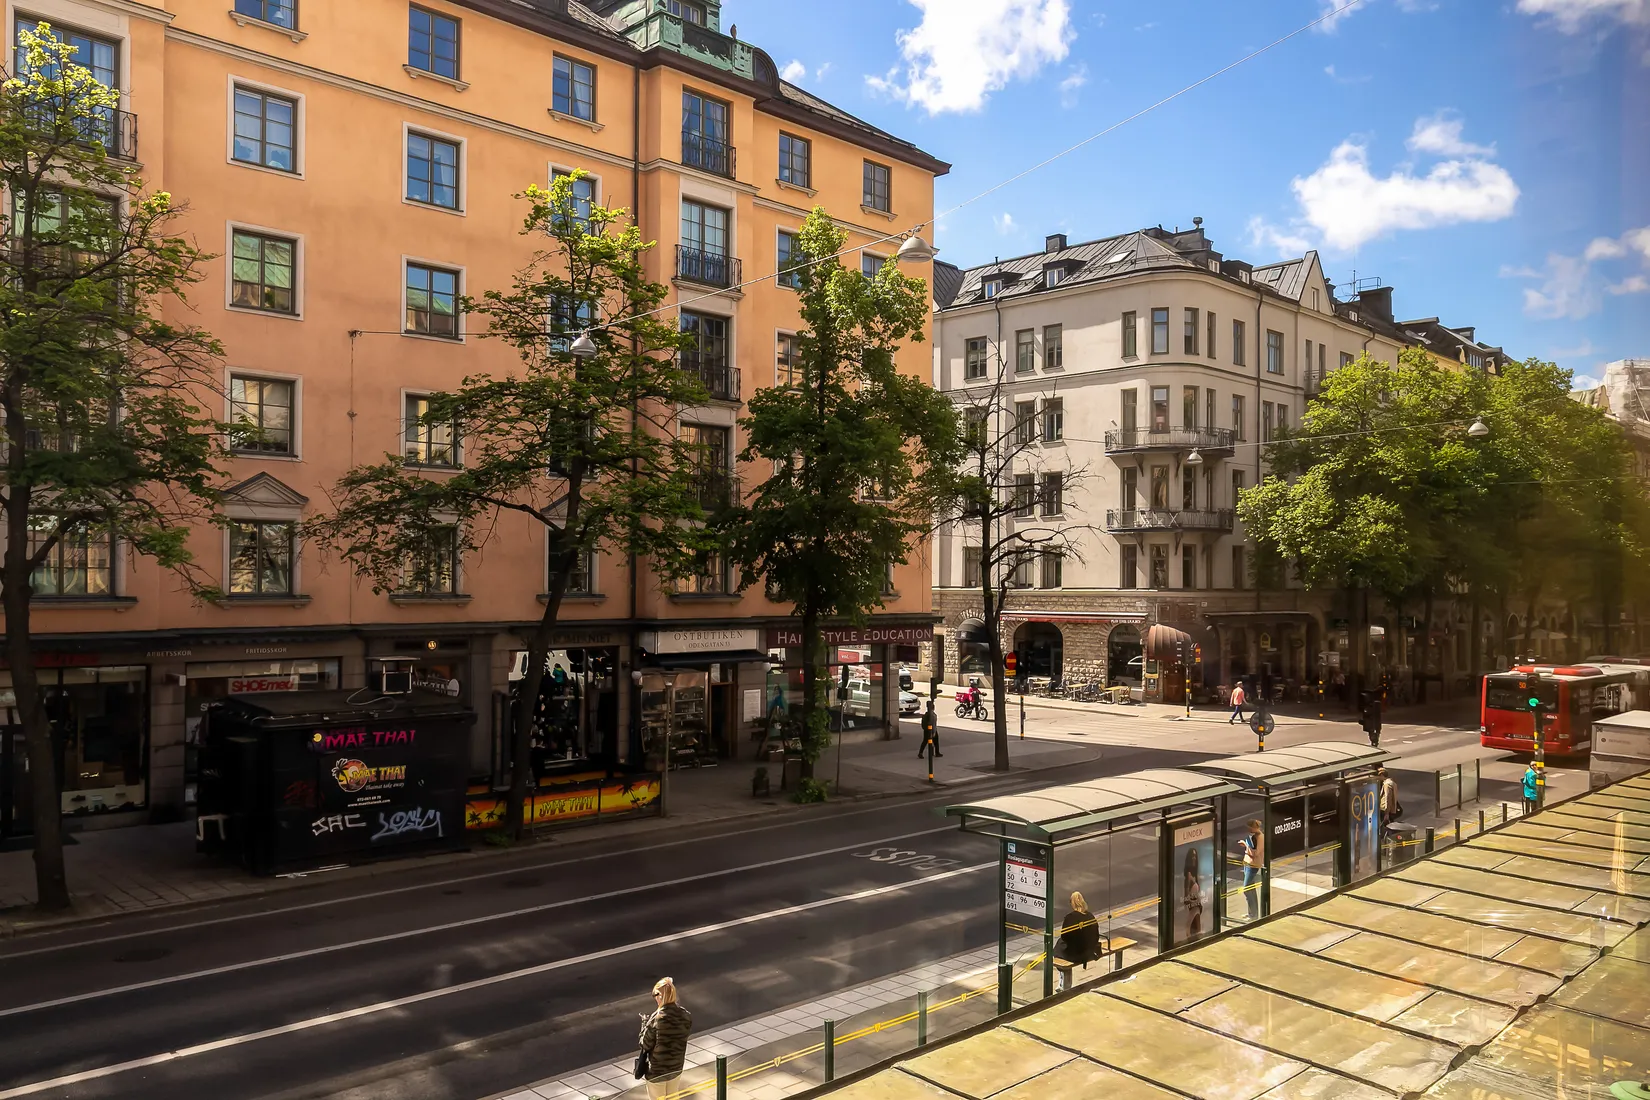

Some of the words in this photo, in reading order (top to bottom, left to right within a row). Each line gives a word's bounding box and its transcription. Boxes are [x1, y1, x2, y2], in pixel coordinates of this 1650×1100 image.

[674, 630, 744, 641] OSTBUTIKEN
[777, 631, 804, 644] HAI
[820, 630, 858, 643] STYLE
[863, 628, 931, 642] EDUCATION
[688, 641, 724, 649] ODENGATAN
[373, 729, 416, 745] THAI
[378, 764, 407, 780] THAI
[568, 796, 594, 812] THAI
[1351, 791, 1375, 821] Q10
[1183, 828, 1203, 841] LINDEX
[1007, 864, 1011, 872] 2
[1007, 873, 1014, 881] 50
[1020, 876, 1027, 884] 61
[1034, 879, 1041, 887] 67
[1007, 893, 1014, 901] 94
[1020, 896, 1027, 904] 96
[1033, 900, 1045, 909] 690
[1007, 903, 1017, 911] 691
